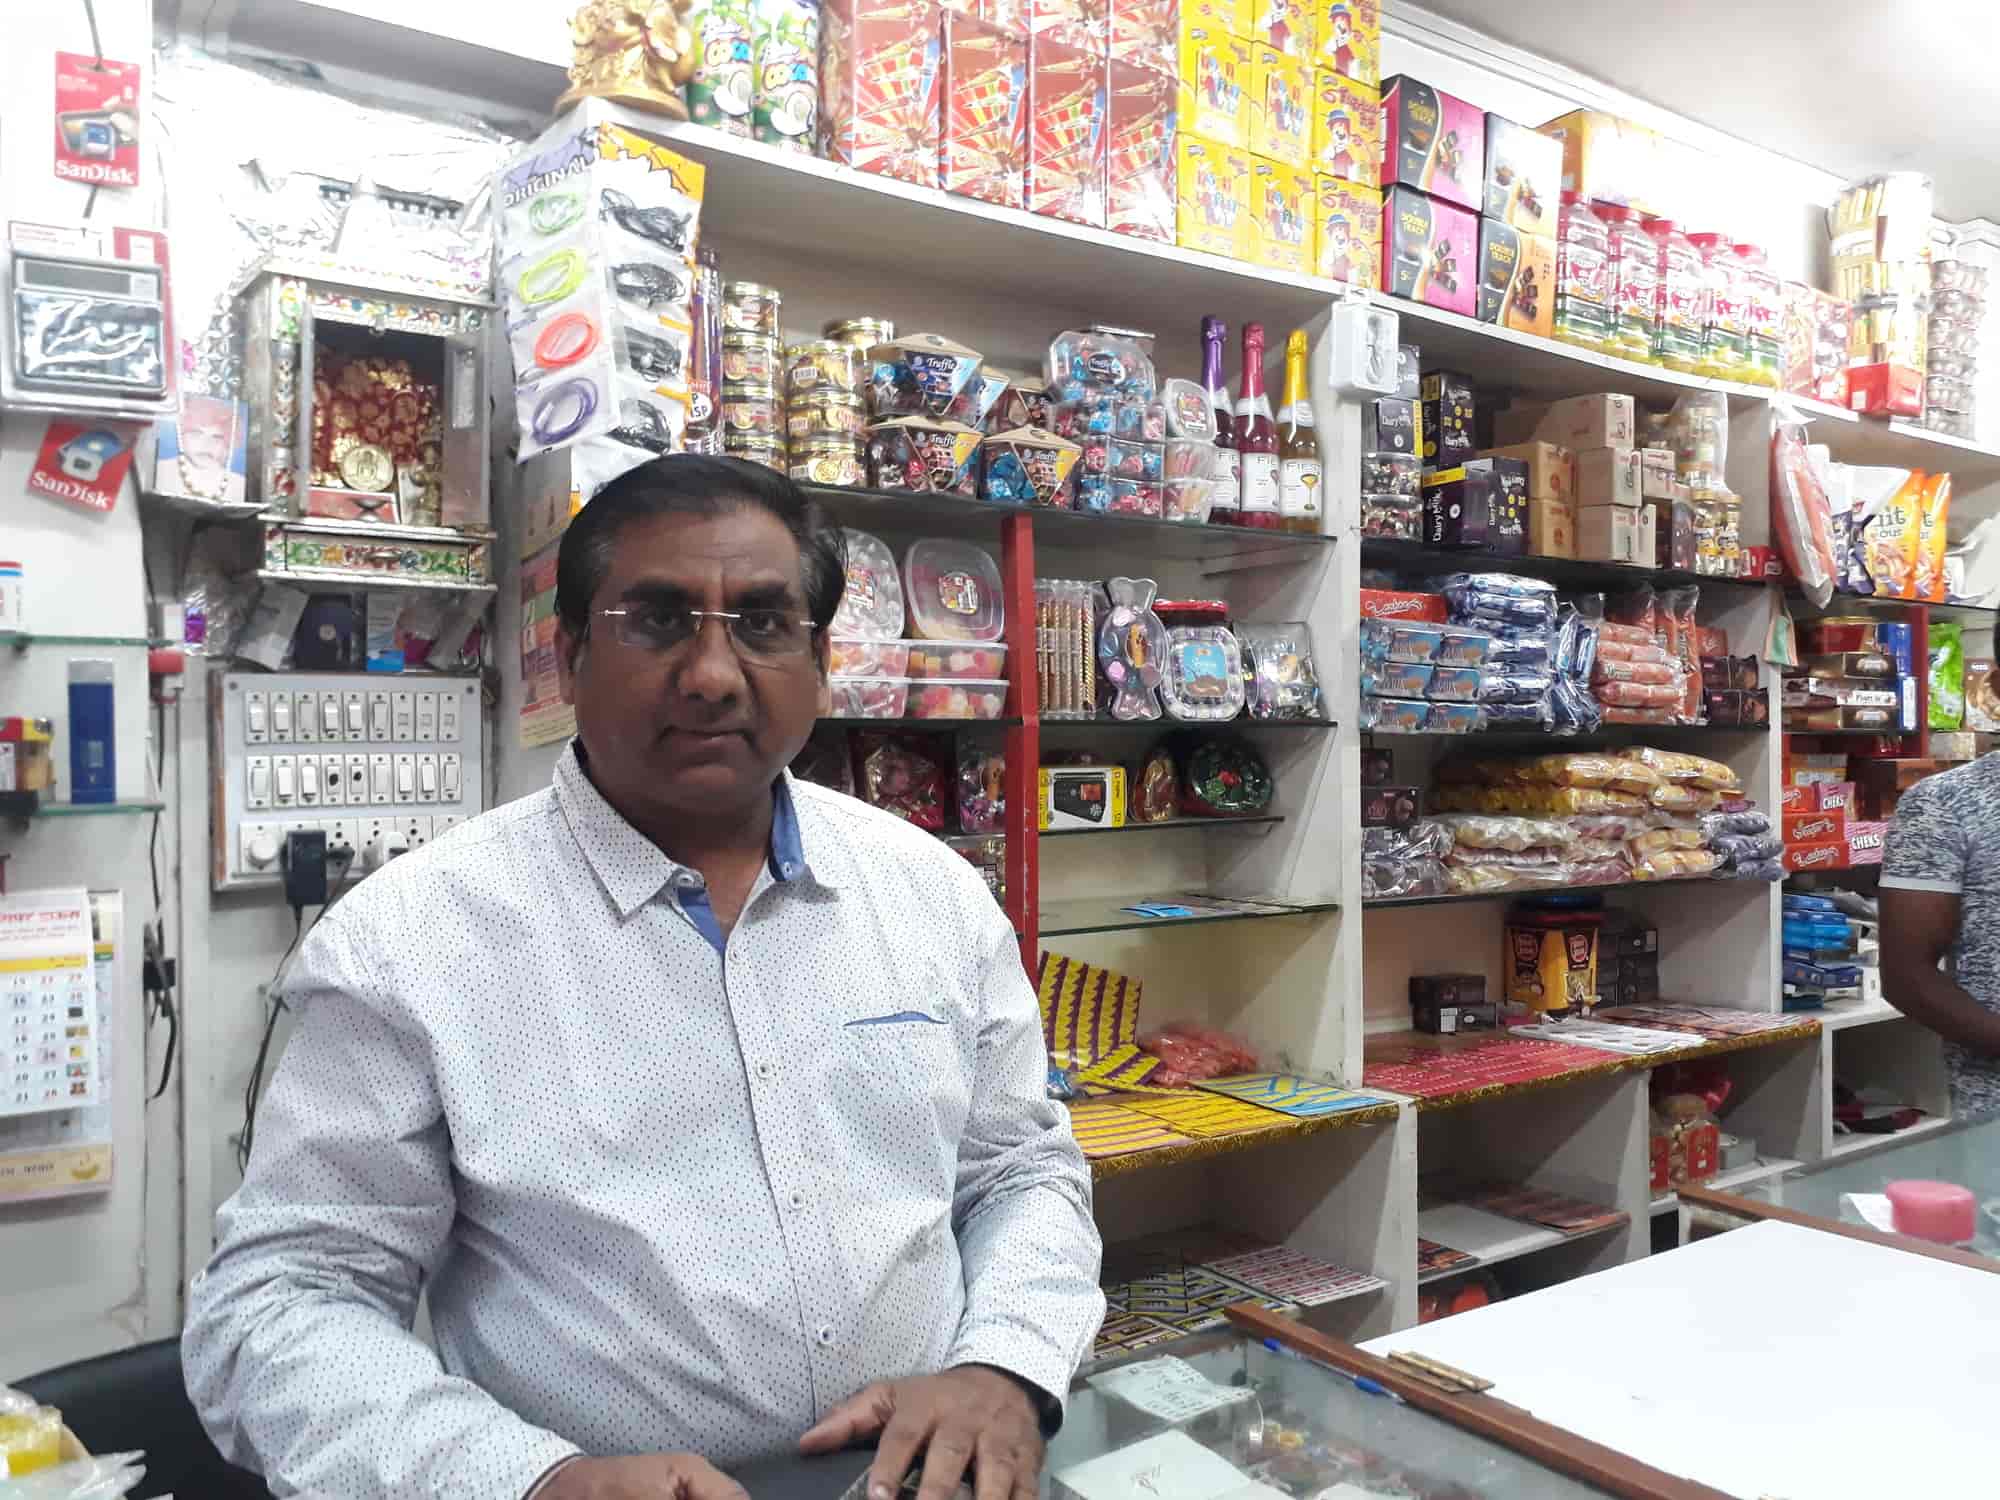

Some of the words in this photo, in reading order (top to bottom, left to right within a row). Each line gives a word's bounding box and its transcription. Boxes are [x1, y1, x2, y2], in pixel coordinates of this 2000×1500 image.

[56, 160, 136, 184] SanDisk
[32, 470, 112, 509] SanDisk
[1851, 832, 1881, 850] CHEKS
